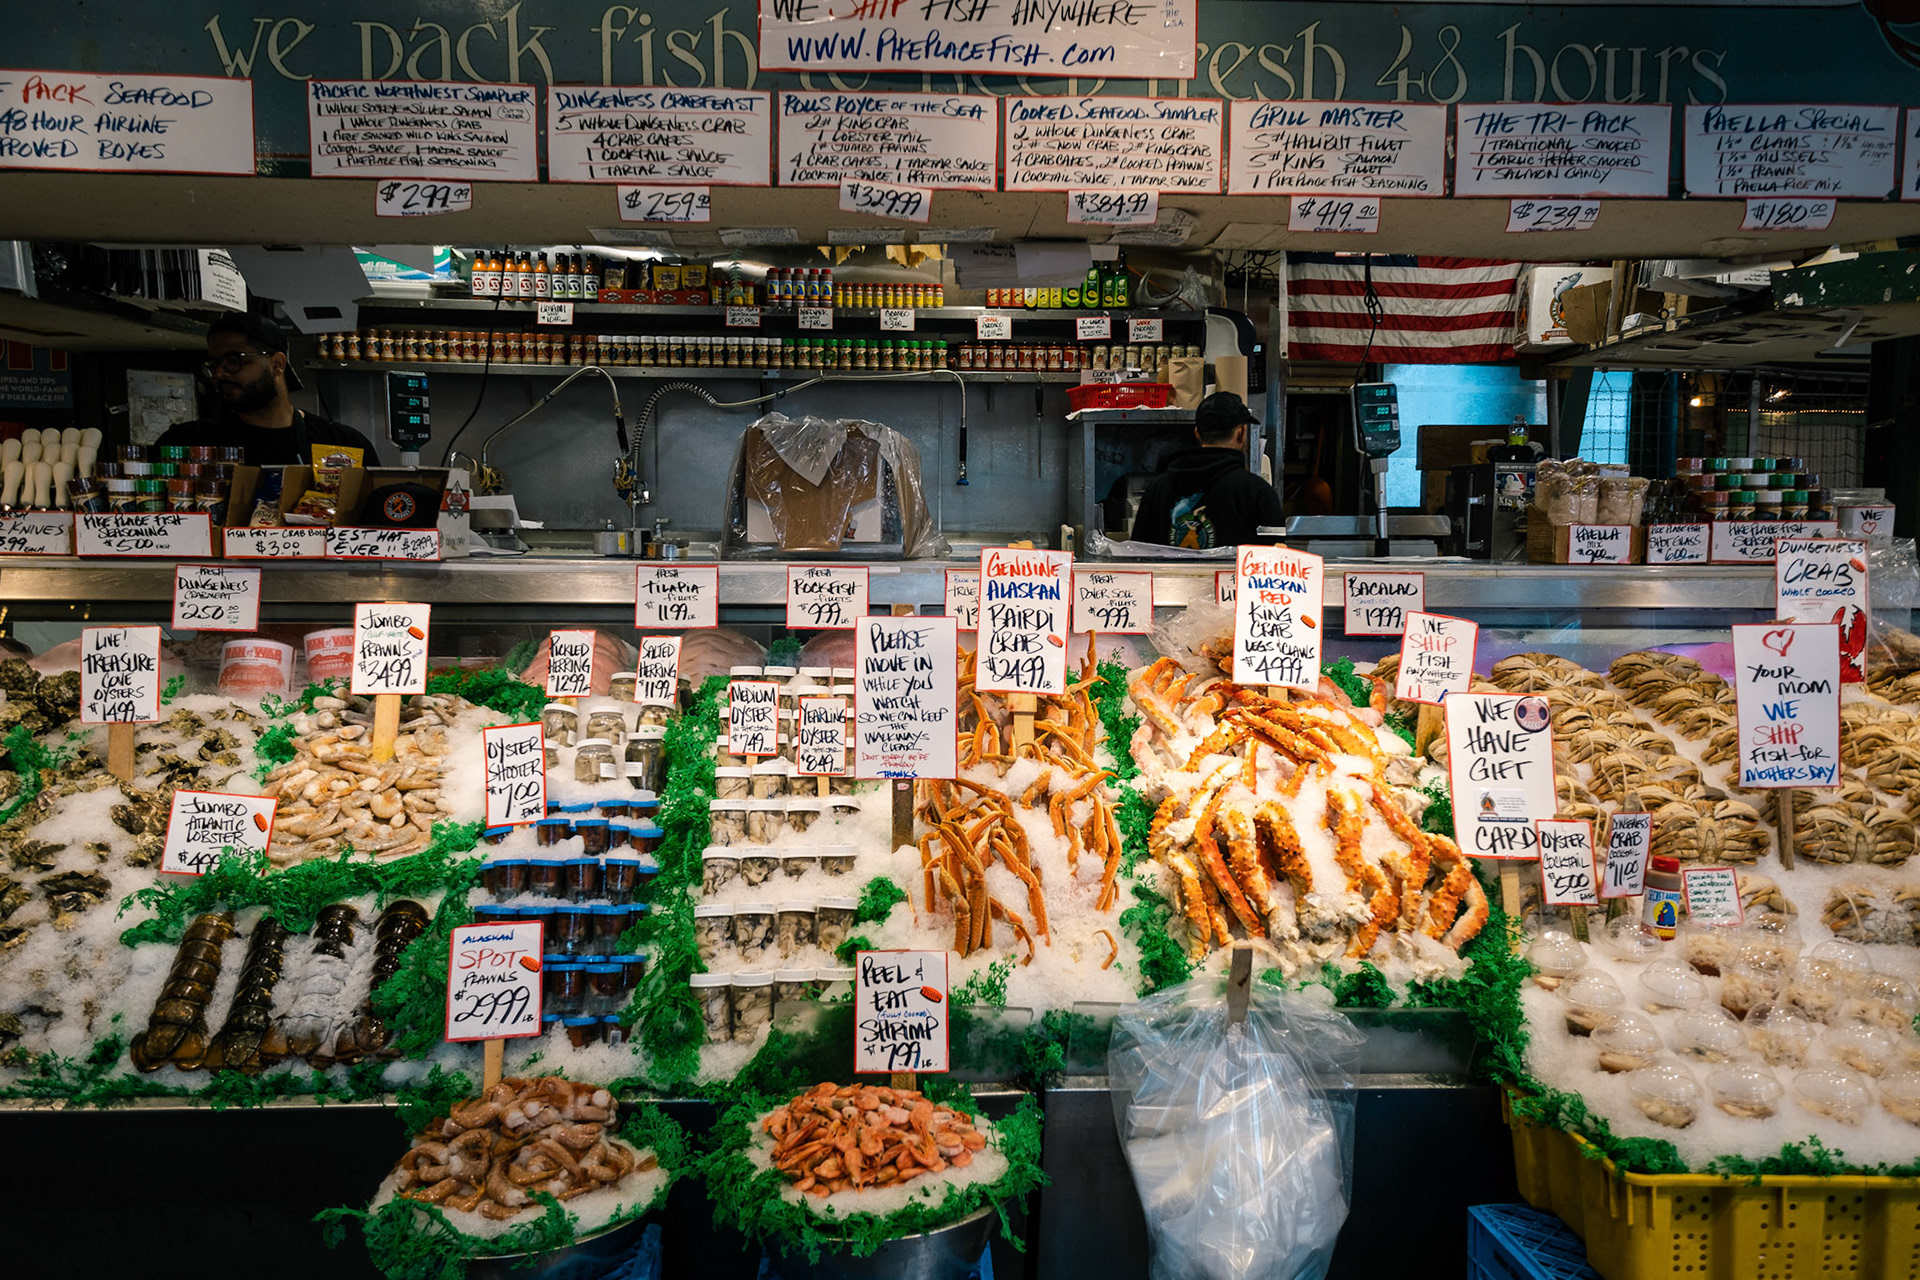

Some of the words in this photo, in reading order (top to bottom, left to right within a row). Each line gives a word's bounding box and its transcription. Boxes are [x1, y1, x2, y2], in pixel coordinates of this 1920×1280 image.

[1011, 0, 1157, 33] ANYWHERE
[203, 14, 315, 84] we
[591, 6, 761, 92] fish
[1378, 24, 1468, 104] 48
[1495, 21, 1730, 104] hours
[23, 75, 96, 107] PACK
[104, 82, 214, 109] SEAFOOD
[312, 83, 369, 102] PACIFIC
[375, 84, 463, 101] NORTHWEST
[464, 87, 534, 106] SAMPLER
[555, 89, 655, 111] DUNGENESS
[836, 96, 888, 116] ROYCE
[942, 98, 988, 119] SEA
[1010, 100, 1072, 123] COOKED
[1076, 98, 1145, 120] SEAFOOD
[1147, 101, 1219, 125] SAMPLER
[0, 107, 28, 135] 48
[31, 110, 89, 135] HOUR
[94, 111, 177, 134] AIRLINE
[579, 114, 624, 131] WHOLE
[625, 113, 699, 131] DUNGENESS
[702, 118, 746, 134] CRAB
[837, 116, 872, 131] KING
[874, 115, 909, 130] CRAB
[1250, 104, 1310, 129] GRILL
[1320, 107, 1407, 131] MASTER
[1464, 112, 1525, 137] THE
[1702, 105, 1794, 134] PAELLA
[1794, 108, 1885, 132] SPECIAL
[832, 131, 894, 143] LOBSTER
[1035, 124, 1079, 139] WHOLE
[1083, 123, 1154, 140] DUNGENESS
[1161, 127, 1195, 141] CRAB
[1285, 132, 1355, 151] HALIBUT
[1358, 134, 1411, 151] FILLET
[98, 140, 166, 162] BOXES
[1488, 137, 1578, 151] TRADITIONAL
[1582, 138, 1641, 151] SMOKED
[1750, 135, 1810, 151] CLAMS
[602, 148, 672, 162] COCKTAIL
[676, 149, 734, 164] SAUCE
[1166, 157, 1213, 173] PRAWNS
[1282, 152, 1324, 171] KING
[1338, 153, 1398, 166] SALMON
[1487, 153, 1534, 166] GARLIC
[1587, 154, 1641, 167] SMOKED
[1755, 151, 1829, 164] MUSSELS
[601, 165, 661, 177] TARTAR
[668, 165, 720, 178] SAUCE
[1493, 168, 1559, 180] SALMON
[1564, 167, 1612, 184] CANDY
[1750, 165, 1806, 179] PRAWNS
[1362, 176, 1428, 191] SEASONING
[20, 377, 38, 385] AND
[8, 393, 27, 401] PIKE
[84, 514, 112, 530] PIKE
[115, 513, 149, 529] PLACE
[154, 514, 189, 527] FISH
[1861, 509, 1885, 521] WE
[8, 520, 65, 536] KNIVES
[98, 526, 169, 539] SEASONING
[227, 529, 246, 539] FISH
[282, 529, 305, 538] CRAB
[377, 530, 410, 542] HAT
[1575, 525, 1620, 543] PAELLA
[1778, 542, 1864, 555] DUNGENESS
[987, 552, 1062, 577] GENUINE
[1241, 551, 1313, 580] GENUINE
[1784, 558, 1854, 587] CRAB
[178, 574, 249, 593] DUNGENESS
[642, 580, 705, 595] TILAPIA
[794, 579, 862, 596] ROCKFISH
[986, 578, 1061, 601] ALASKAN
[1248, 576, 1307, 594] ALASKAN
[1348, 576, 1418, 598] BACALAO
[1781, 588, 1813, 598] WHOLE
[1815, 587, 1856, 598] COOKED
[1259, 590, 1292, 605] RED
[361, 609, 413, 631] JUMBO
[988, 603, 1053, 633] BAIRDI
[1249, 601, 1293, 624] KING
[1250, 621, 1293, 639] CRAB
[1423, 618, 1454, 636] WE
[550, 636, 589, 658] PICKLED
[870, 623, 935, 653] PLEASE
[990, 631, 1044, 655] CRAB
[1245, 639, 1275, 652] LEGS
[1409, 633, 1457, 652] SHIP
[360, 640, 412, 660] PRAWNS
[642, 640, 675, 659] SALTED
[83, 652, 156, 674] TREASURE
[548, 657, 591, 675] HERRING
[865, 652, 910, 675] MOVE
[1416, 651, 1456, 669] FISH
[639, 660, 677, 680] HERRING
[1746, 664, 1801, 683] YOUR
[102, 672, 133, 689] COVE
[863, 676, 901, 692] WHILE
[903, 671, 933, 697] YOU
[1778, 680, 1831, 696] MOM
[94, 686, 145, 703] OYSTERS
[731, 684, 776, 706] MEDIUM
[872, 694, 921, 711] WATCH
[732, 705, 773, 727] OYSTER
[800, 703, 846, 726] YEARLING
[858, 712, 878, 723] SO
[921, 708, 948, 722] KEEP
[1475, 697, 1518, 724] WE
[1762, 699, 1801, 721] WE
[801, 727, 844, 747] OYSTER
[865, 731, 930, 745] WALKWAYS
[1464, 726, 1531, 755] HAVE
[1753, 721, 1803, 746] SHIP
[487, 736, 543, 764] OYSTER
[882, 742, 922, 753] CLEAR
[486, 758, 543, 784] SHOOTER
[877, 770, 918, 780] THANKS
[1469, 757, 1533, 781] GIFT
[1745, 764, 1808, 783] MOTHERS
[1809, 763, 1836, 784] DAY
[181, 797, 248, 817] JUMBO
[185, 815, 247, 833] ATLANTIC
[1612, 816, 1650, 831] DUNGENESS
[187, 830, 248, 847] LOBSTER
[1475, 826, 1537, 855] CARD
[1539, 829, 1590, 852] OYSTER
[1610, 831, 1643, 849] CRAB
[1543, 853, 1590, 871] COCKTAIL
[462, 929, 515, 944] ALASKAN
[458, 949, 529, 970] SPOT
[463, 971, 518, 989] PRAWNS
[862, 956, 910, 987] PEEL
[869, 986, 921, 1011] EAT
[859, 1016, 939, 1043] SHRIMP
